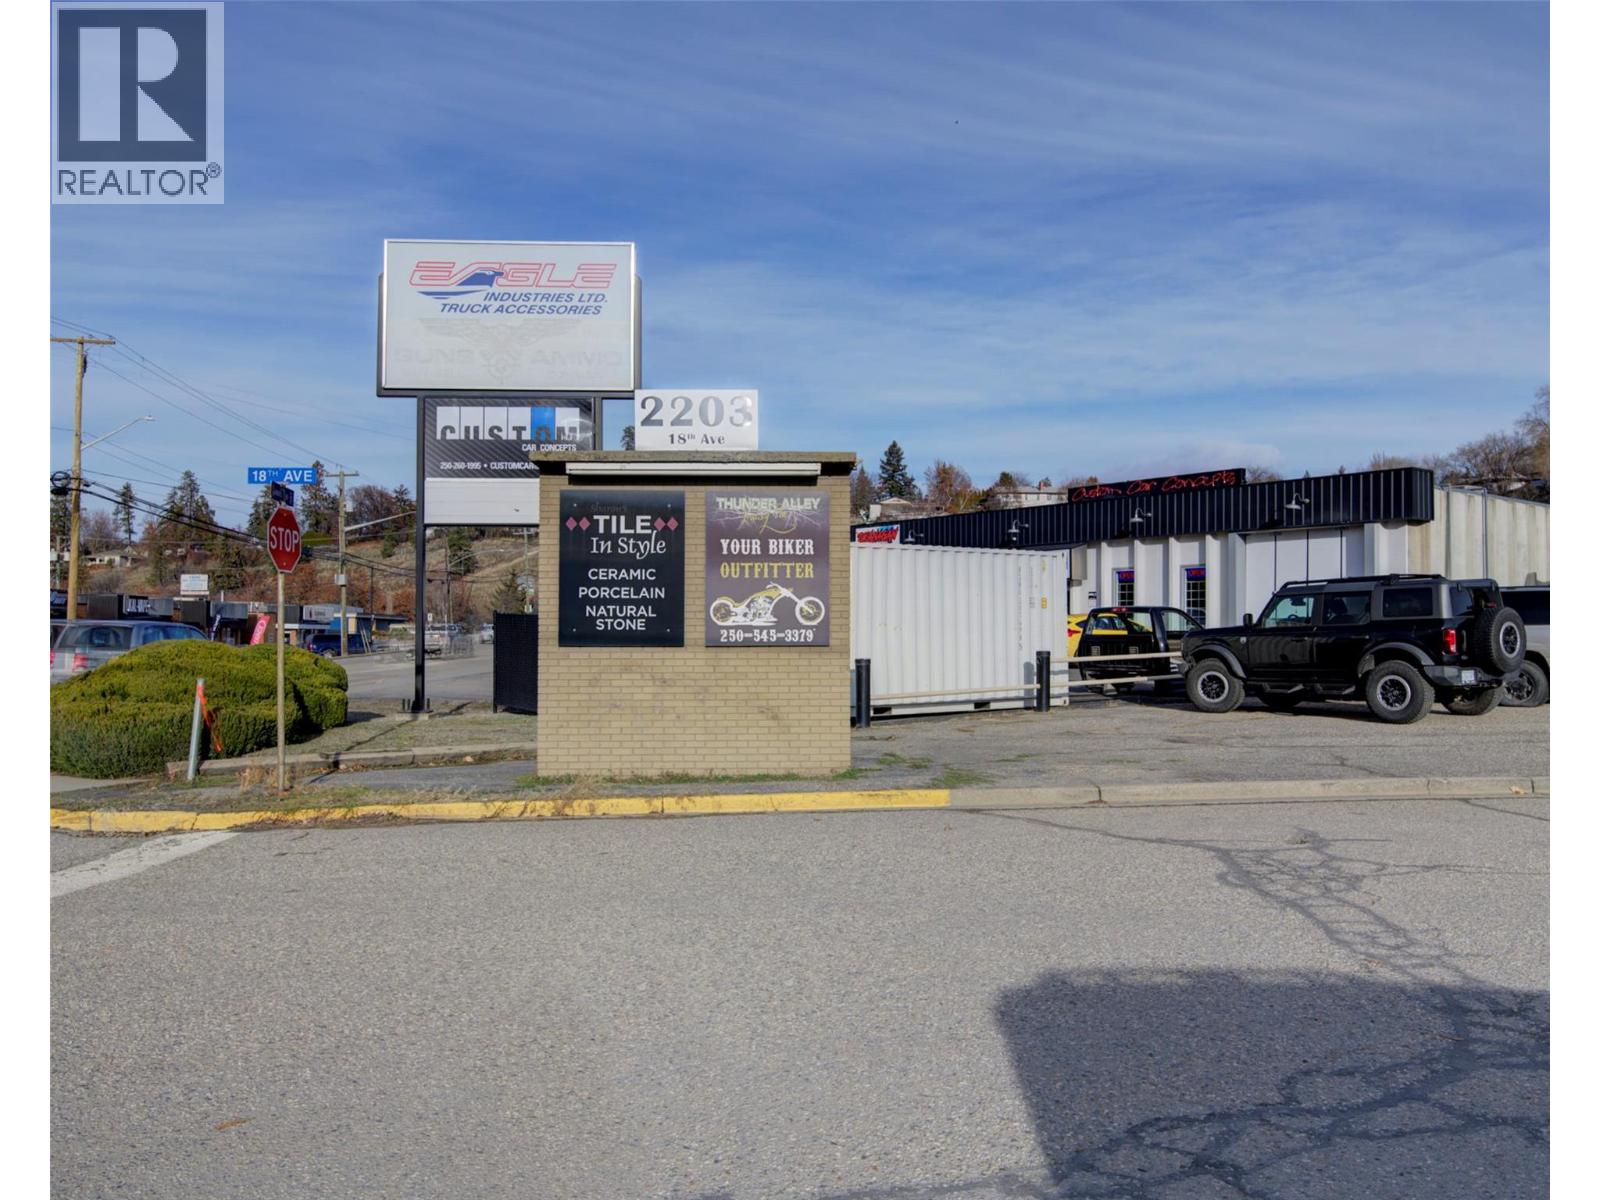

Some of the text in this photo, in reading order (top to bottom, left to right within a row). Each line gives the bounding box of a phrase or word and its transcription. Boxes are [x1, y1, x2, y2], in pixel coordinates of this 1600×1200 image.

[409, 261, 617, 289] EAGLE
[483, 291, 609, 303] INDUSTRIES LTD.
[440, 303, 603, 315] TRUCK ACCESSORIES
[640, 395, 753, 428] 2203
[440, 424, 578, 442] CUSTOM
[700, 433, 725, 445] Ave
[521, 443, 577, 452] CAR CONCEPTS
[252, 469, 313, 482] 18TH AVE
[1126, 479, 1157, 495] Car
[1161, 470, 1236, 491] Concepts
[715, 496, 821, 510] THUNDER ALLEY
[593, 515, 652, 534] TILE
[270, 525, 300, 553] STOP
[590, 530, 666, 560] In Style
[720, 539, 814, 555] YOUR BIKER
[588, 568, 656, 581] CERAMIC
[720, 562, 814, 578] OUTFITTER
[578, 587, 665, 599] PORCELAIN
[585, 605, 657, 617] NATURAL
[595, 618, 646, 631] STONE
[720, 629, 815, 642] 250-545-3379
